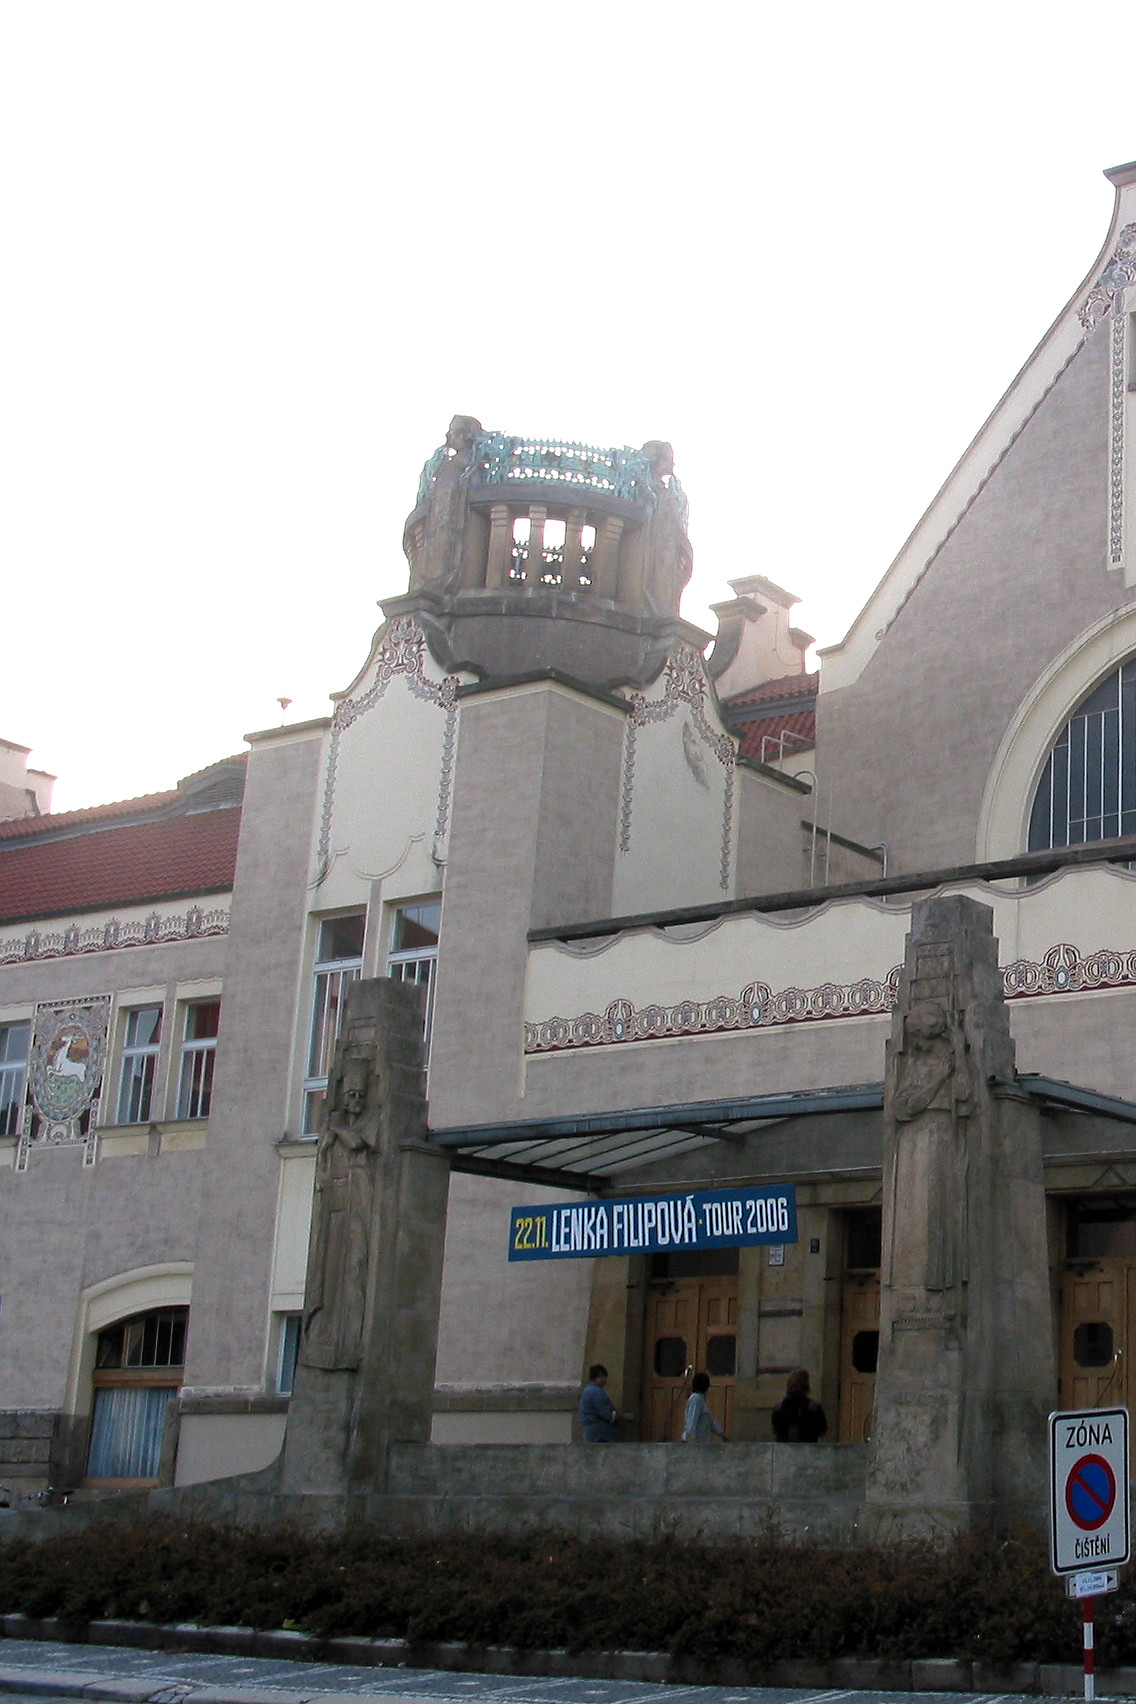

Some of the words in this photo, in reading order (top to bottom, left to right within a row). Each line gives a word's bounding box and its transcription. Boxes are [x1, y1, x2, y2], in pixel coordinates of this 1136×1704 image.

[551, 1206, 608, 1252] LENKA
[612, 1195, 697, 1248] FILIPOVÁ
[702, 1201, 743, 1237] TOUR
[746, 1197, 789, 1233] 2006
[1065, 1420, 1113, 1448] ZÓNA
[1074, 1533, 1110, 1560] ČIŠTĚNÍ
